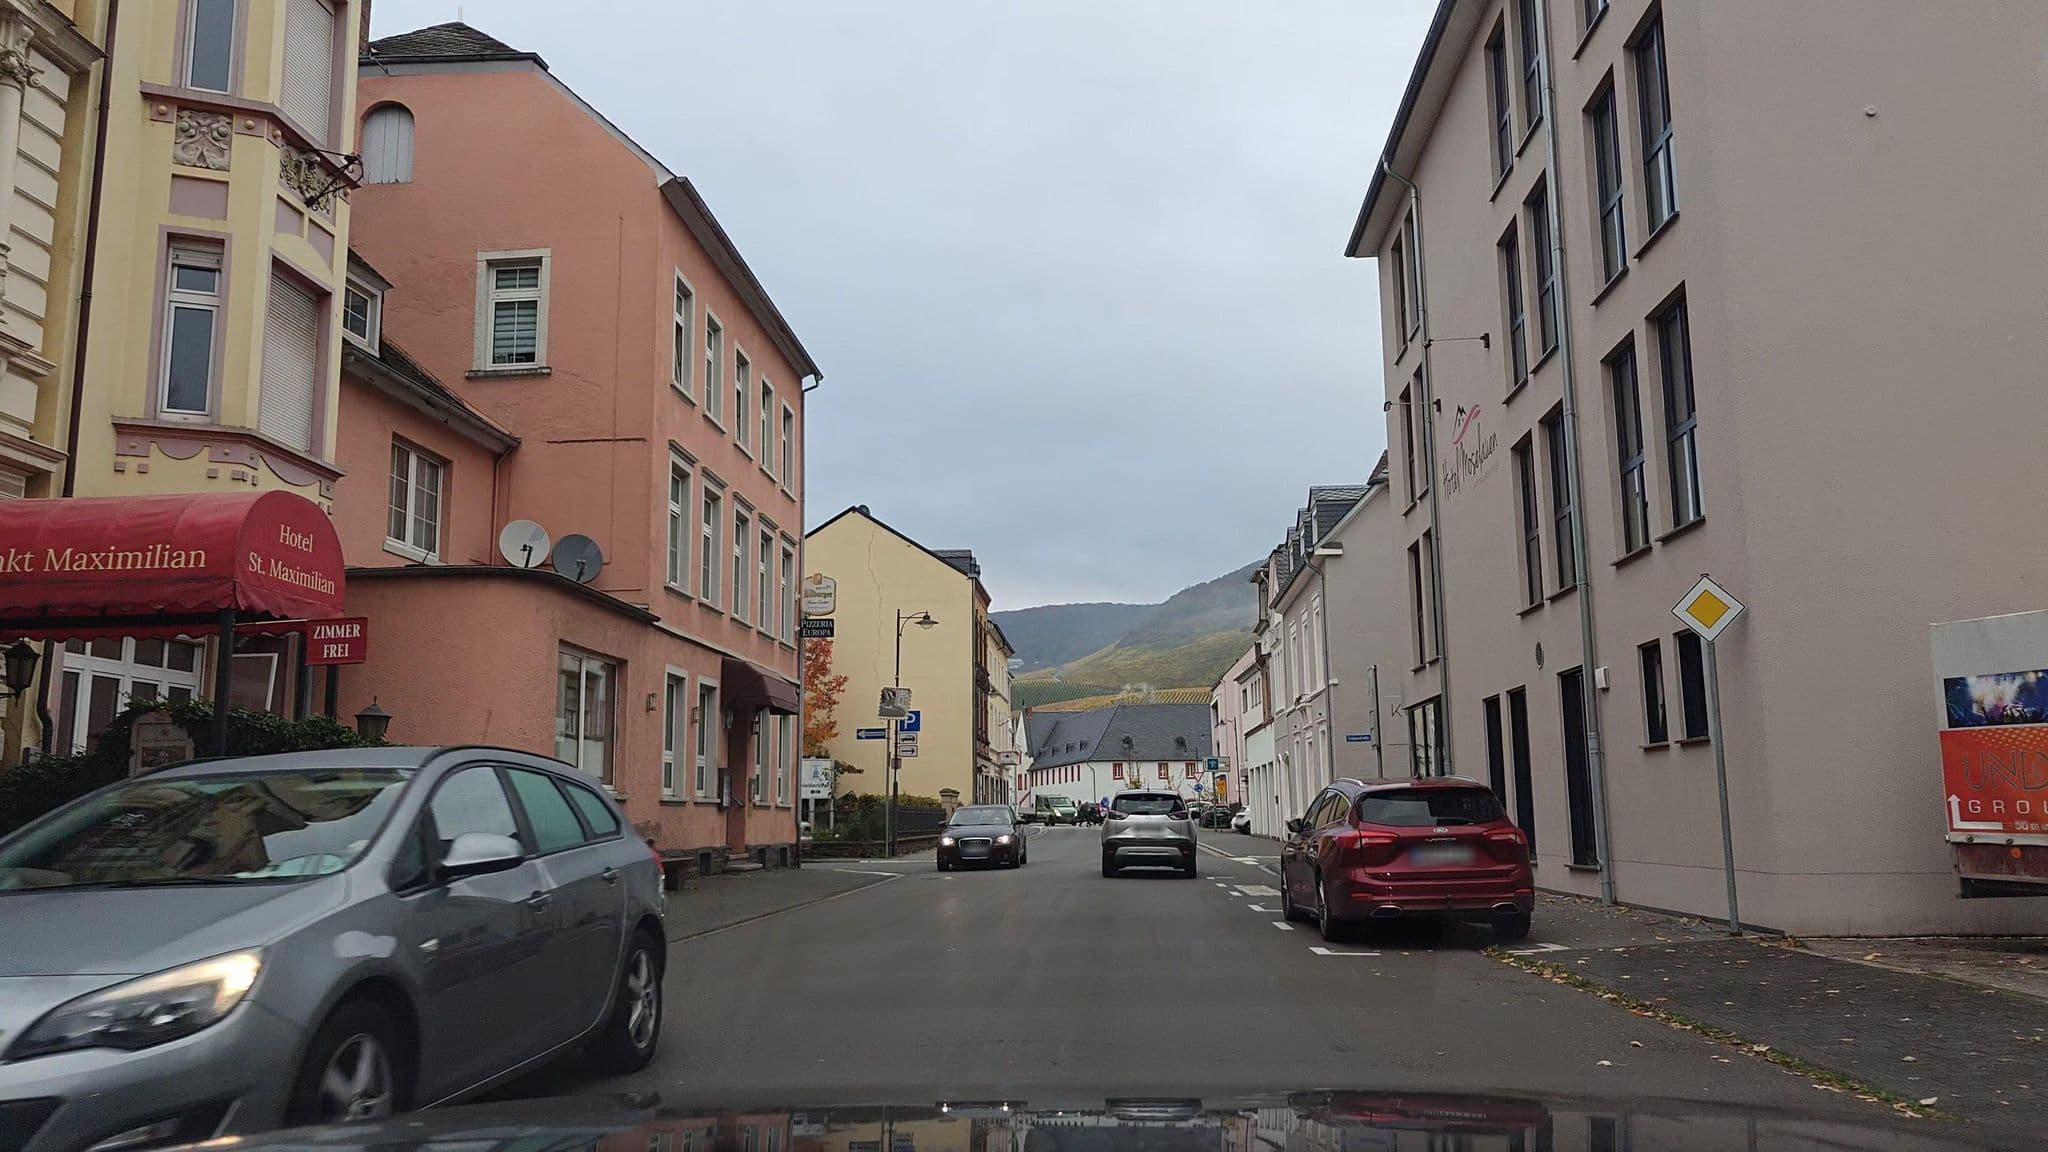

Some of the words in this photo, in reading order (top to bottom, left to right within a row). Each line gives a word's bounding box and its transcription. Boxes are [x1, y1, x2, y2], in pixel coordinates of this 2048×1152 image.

[279, 524, 313, 553] Hotel
[43, 544, 207, 573] Maximilian
[249, 553, 266, 576] St.
[269, 562, 335, 595] Maximilian
[313, 625, 361, 639] ZIMMER
[802, 629, 831, 637] EUROPA
[323, 644, 349, 658] FREI
[904, 713, 916, 729] P
